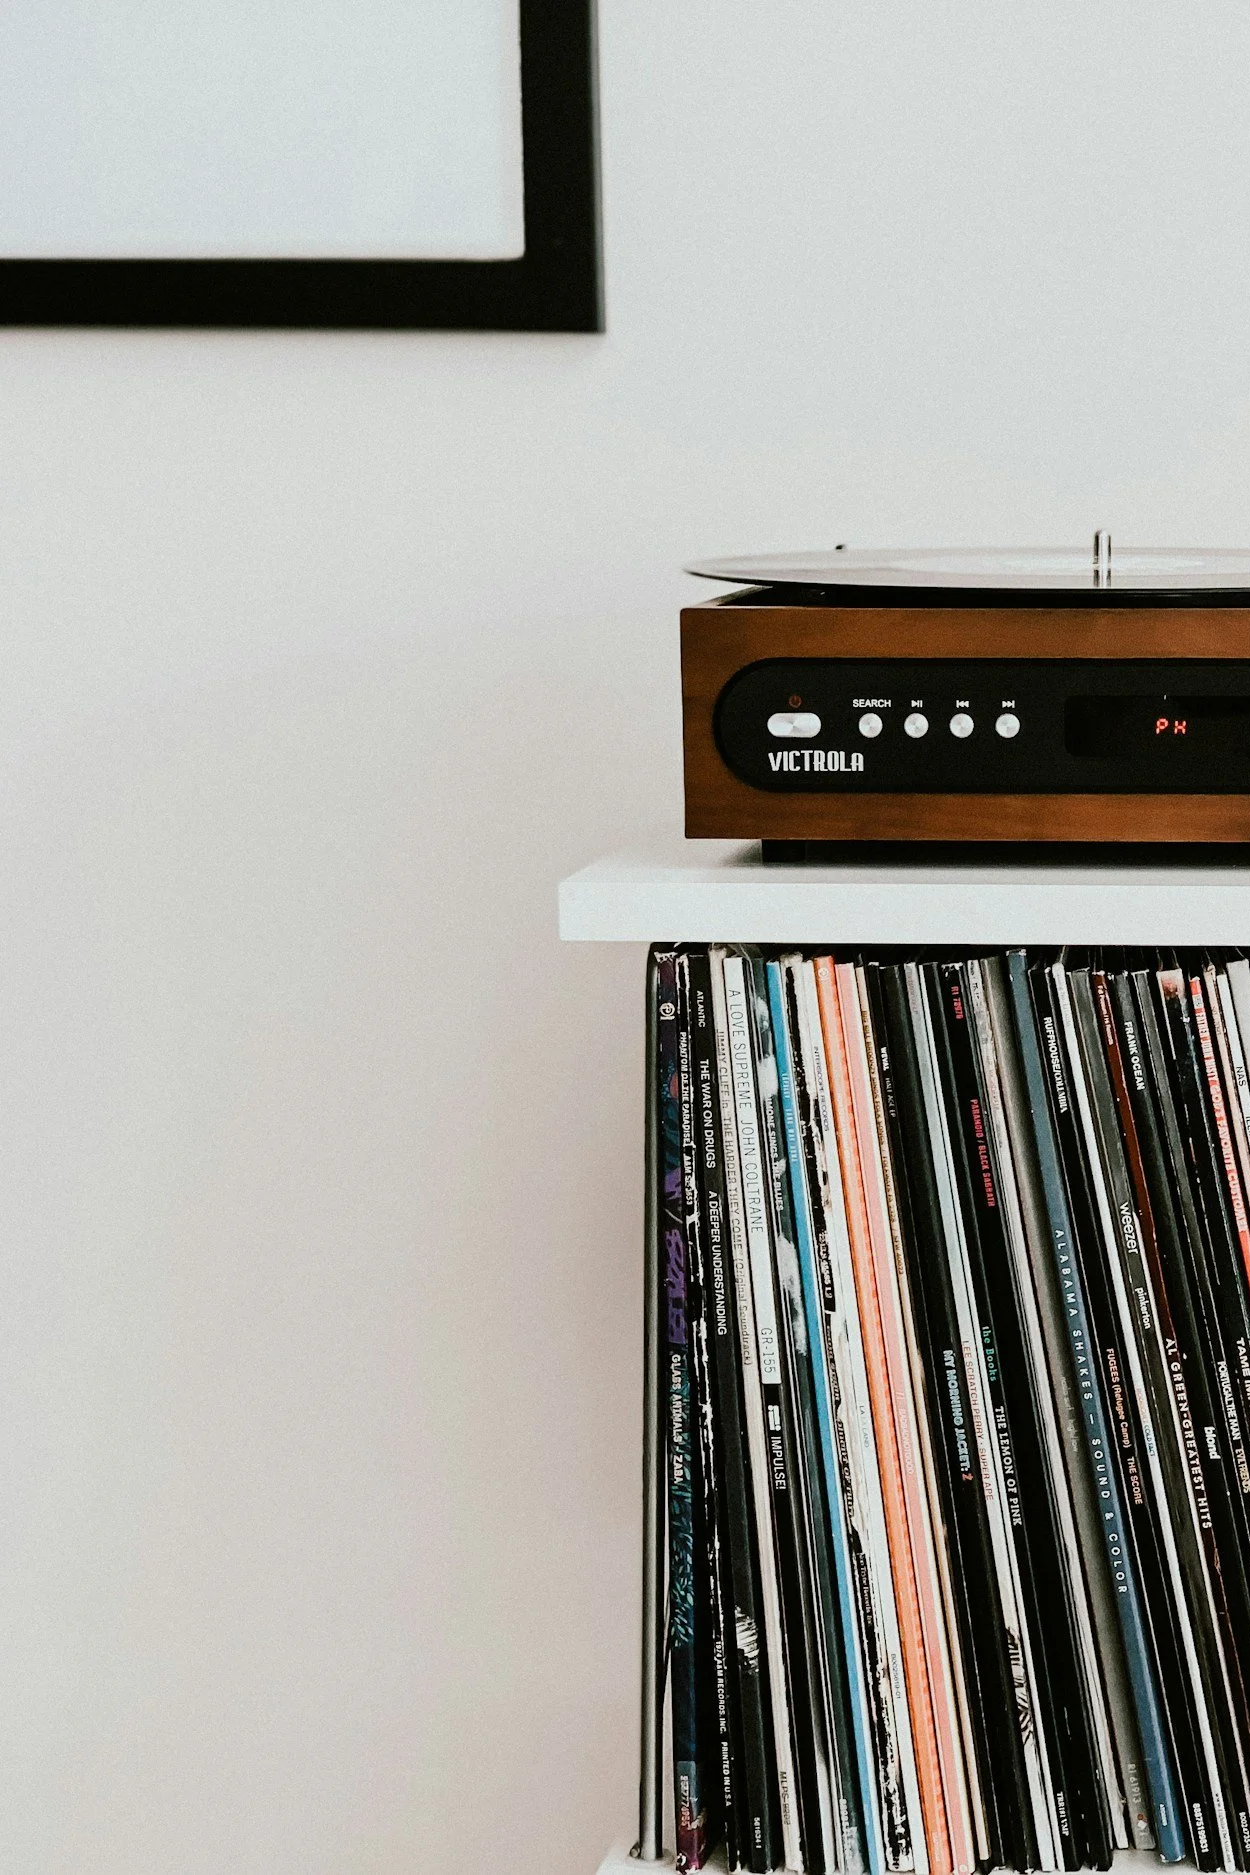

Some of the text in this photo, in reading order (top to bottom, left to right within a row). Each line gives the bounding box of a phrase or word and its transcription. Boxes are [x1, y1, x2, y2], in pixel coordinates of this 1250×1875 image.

[852, 698, 892, 709] SEARCH
[768, 750, 864, 772] VICTROLA
[696, 990, 706, 1027] ATLANTIC
[730, 1004, 748, 1037] LOVE
[680, 1032, 690, 1072] PHANTOM
[880, 1047, 890, 1071] WEVAL
[1043, 1016, 1068, 1113] RUFFHOUSE/COLUMBIA
[1124, 1022, 1145, 1090] FRANK OCEAN
[1196, 1012, 1210, 1037] FATHER
[1205, 1059, 1218, 1081] MISTY
[733, 1043, 752, 1110] SUPREME
[814, 1046, 830, 1132] INTERSCOPE RECORDS
[1236, 1066, 1246, 1087] NAS
[682, 1104, 691, 1143] PARADISE
[699, 1059, 716, 1168] THE WAR ON DRUGS
[740, 1120, 756, 1156] JOHN
[724, 1140, 738, 1185] HARDER
[768, 1130, 784, 1211] SINGS THE BLUES
[970, 1099, 996, 1207] PARANOID BLACK SABBATH
[1216, 1120, 1235, 1171] FAVORITE
[1229, 1173, 1248, 1232] CUSTOMER
[728, 1187, 740, 1215] THEY
[745, 1162, 764, 1234] COLTRANE
[708, 1191, 727, 1336] A DEEPER UNDERSTANDING
[1119, 1202, 1152, 1329] weezer pinkerton
[760, 1327, 775, 1373] GR-155
[982, 1326, 998, 1382] the Books
[1236, 1337, 1250, 1376] TAME
[671, 1354, 683, 1484] GLASS ANIMALS ZABA
[859, 1406, 870, 1448] LA LAND
[943, 1350, 971, 1472] MY MORNING JACKET:
[962, 1340, 994, 1501] LEE SCRATCH PERRY SUPER APE
[1055, 1230, 1128, 1593] ALABAMA SHAKES SOUND & COLOR
[1106, 1348, 1143, 1505] FUGEES (Refugee Camp) THE SCORE
[1165, 1338, 1212, 1529] AL HITS
[1229, 1418, 1241, 1440] MAN
[770, 1436, 786, 1490] IMPULSE!
[994, 1406, 1022, 1526] THE LEMON OF PINK
[1204, 1426, 1221, 1460] blond
[1234, 1448, 1244, 1466] EVIL
[720, 1742, 730, 1785] PRINTED IN
